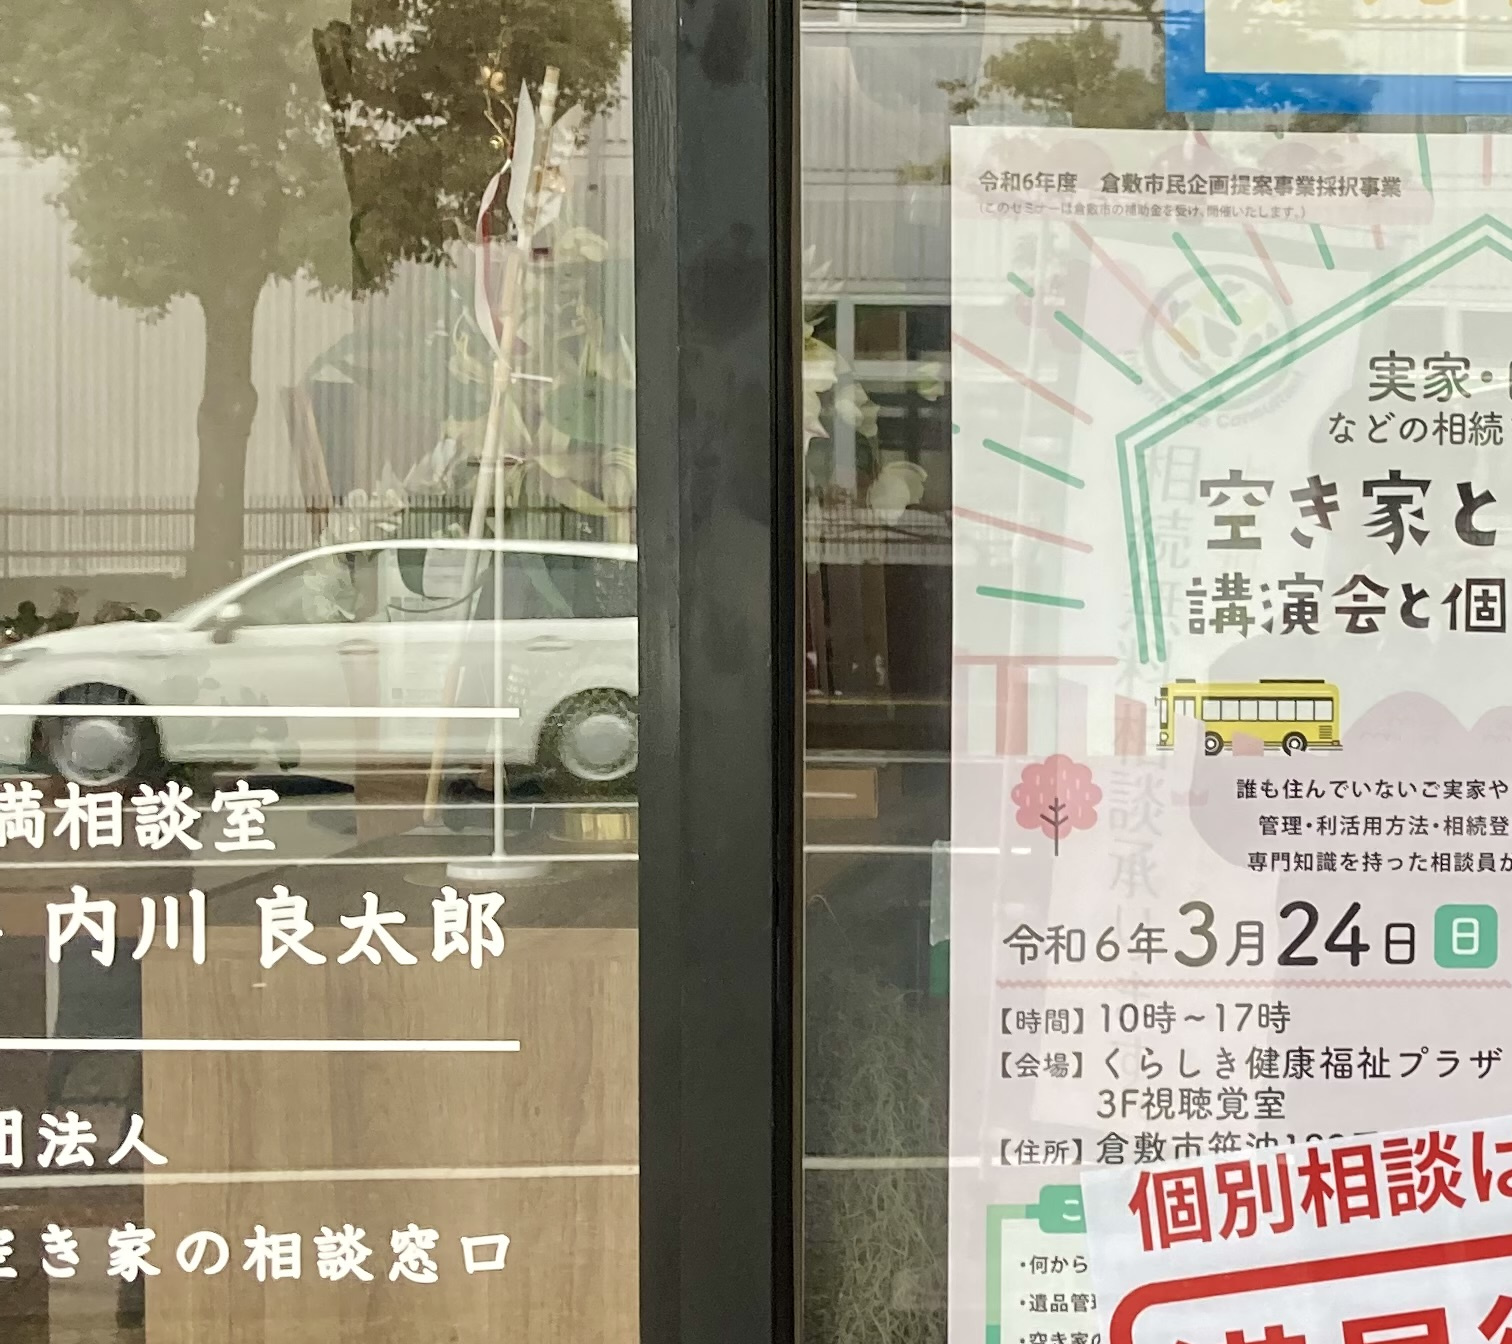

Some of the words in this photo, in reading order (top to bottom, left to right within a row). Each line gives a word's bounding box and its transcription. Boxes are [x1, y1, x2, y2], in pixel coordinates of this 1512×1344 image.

[978, 170, 1078, 193] 令和6年度
[1100, 171, 1402, 198] 倉敷市民企画提案事業採択事業
[46, 885, 207, 967] 内川
[255, 885, 507, 969] 良太郎
[1002, 900, 1416, 968] 令和6年3月24日
[1452, 917, 1480, 956] 日
[1103, 1047, 1504, 1080] くらしき健康福祉プラザ
[1096, 1086, 1286, 1122] 3F視聴覚室
